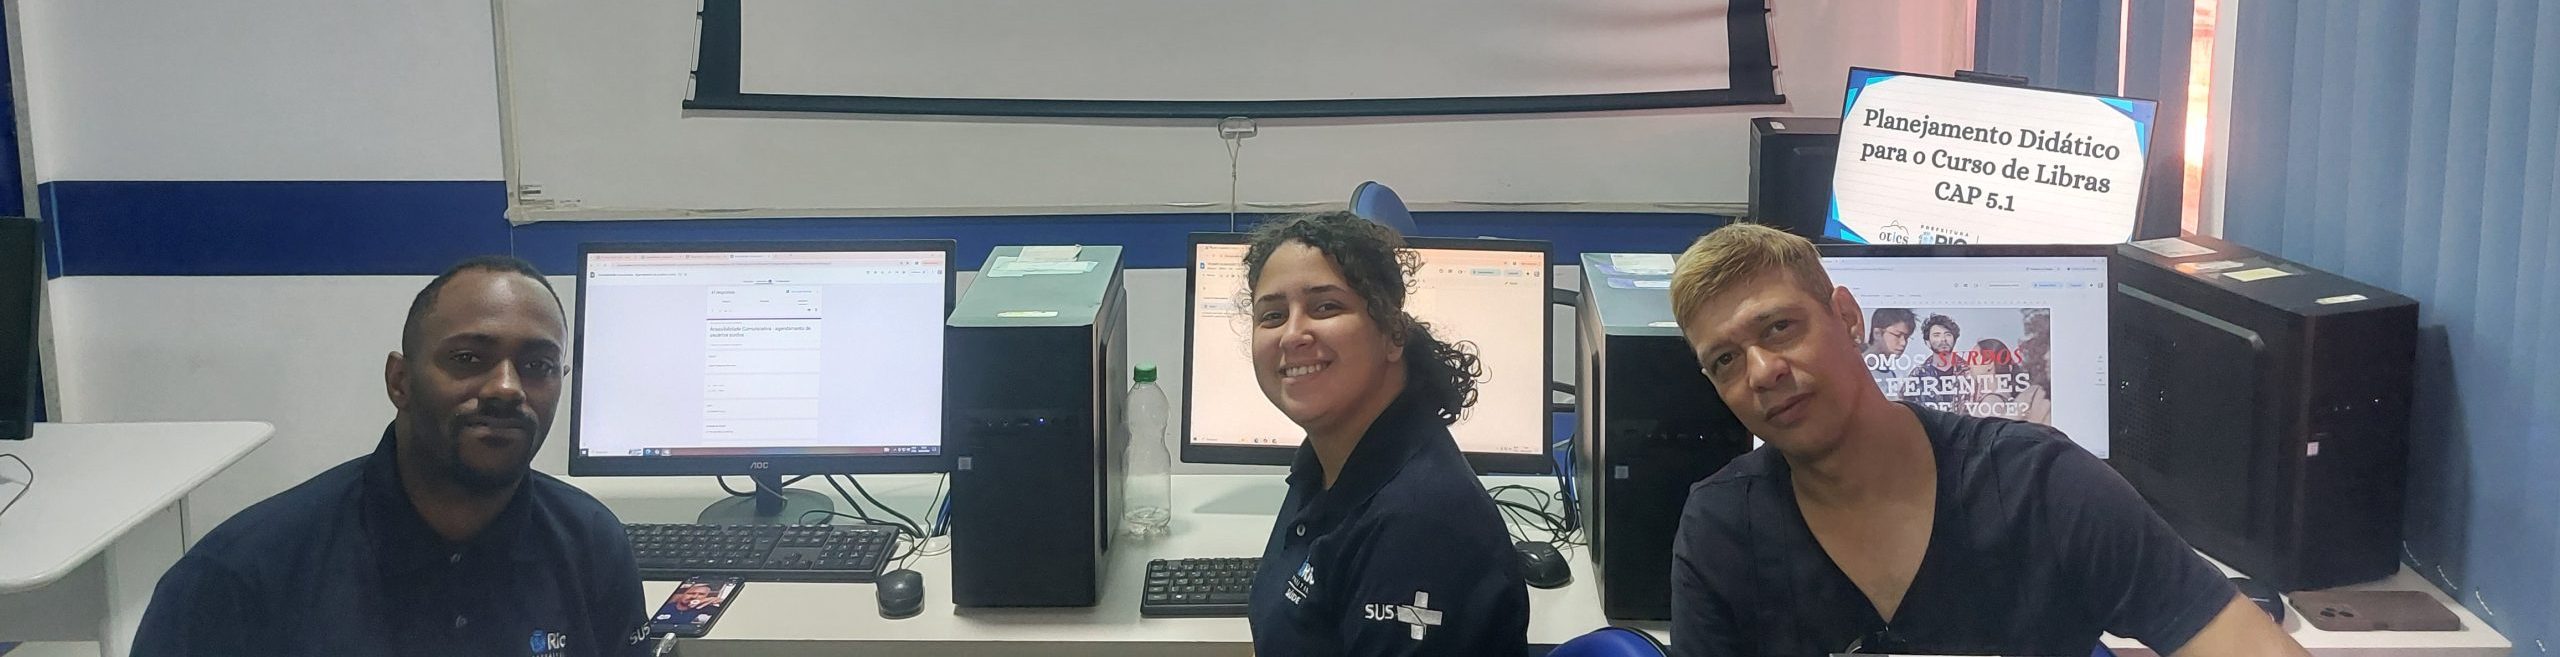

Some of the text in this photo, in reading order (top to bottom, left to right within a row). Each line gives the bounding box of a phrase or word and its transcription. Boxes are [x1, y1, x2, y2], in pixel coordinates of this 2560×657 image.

[1863, 108, 2120, 161] Planejamento Didático
[1860, 142, 2111, 194] para o Curso de Libras
[1934, 181, 2016, 212] CAP 5.1
[1920, 224, 1969, 237] PREFEITURA
[1864, 353, 1926, 371] OMOS
[1875, 373, 2031, 397] FERENTES
[1965, 397, 2030, 416] VOCÊ?
[750, 461, 769, 469] AOC
[1364, 603, 1395, 621] SUS
